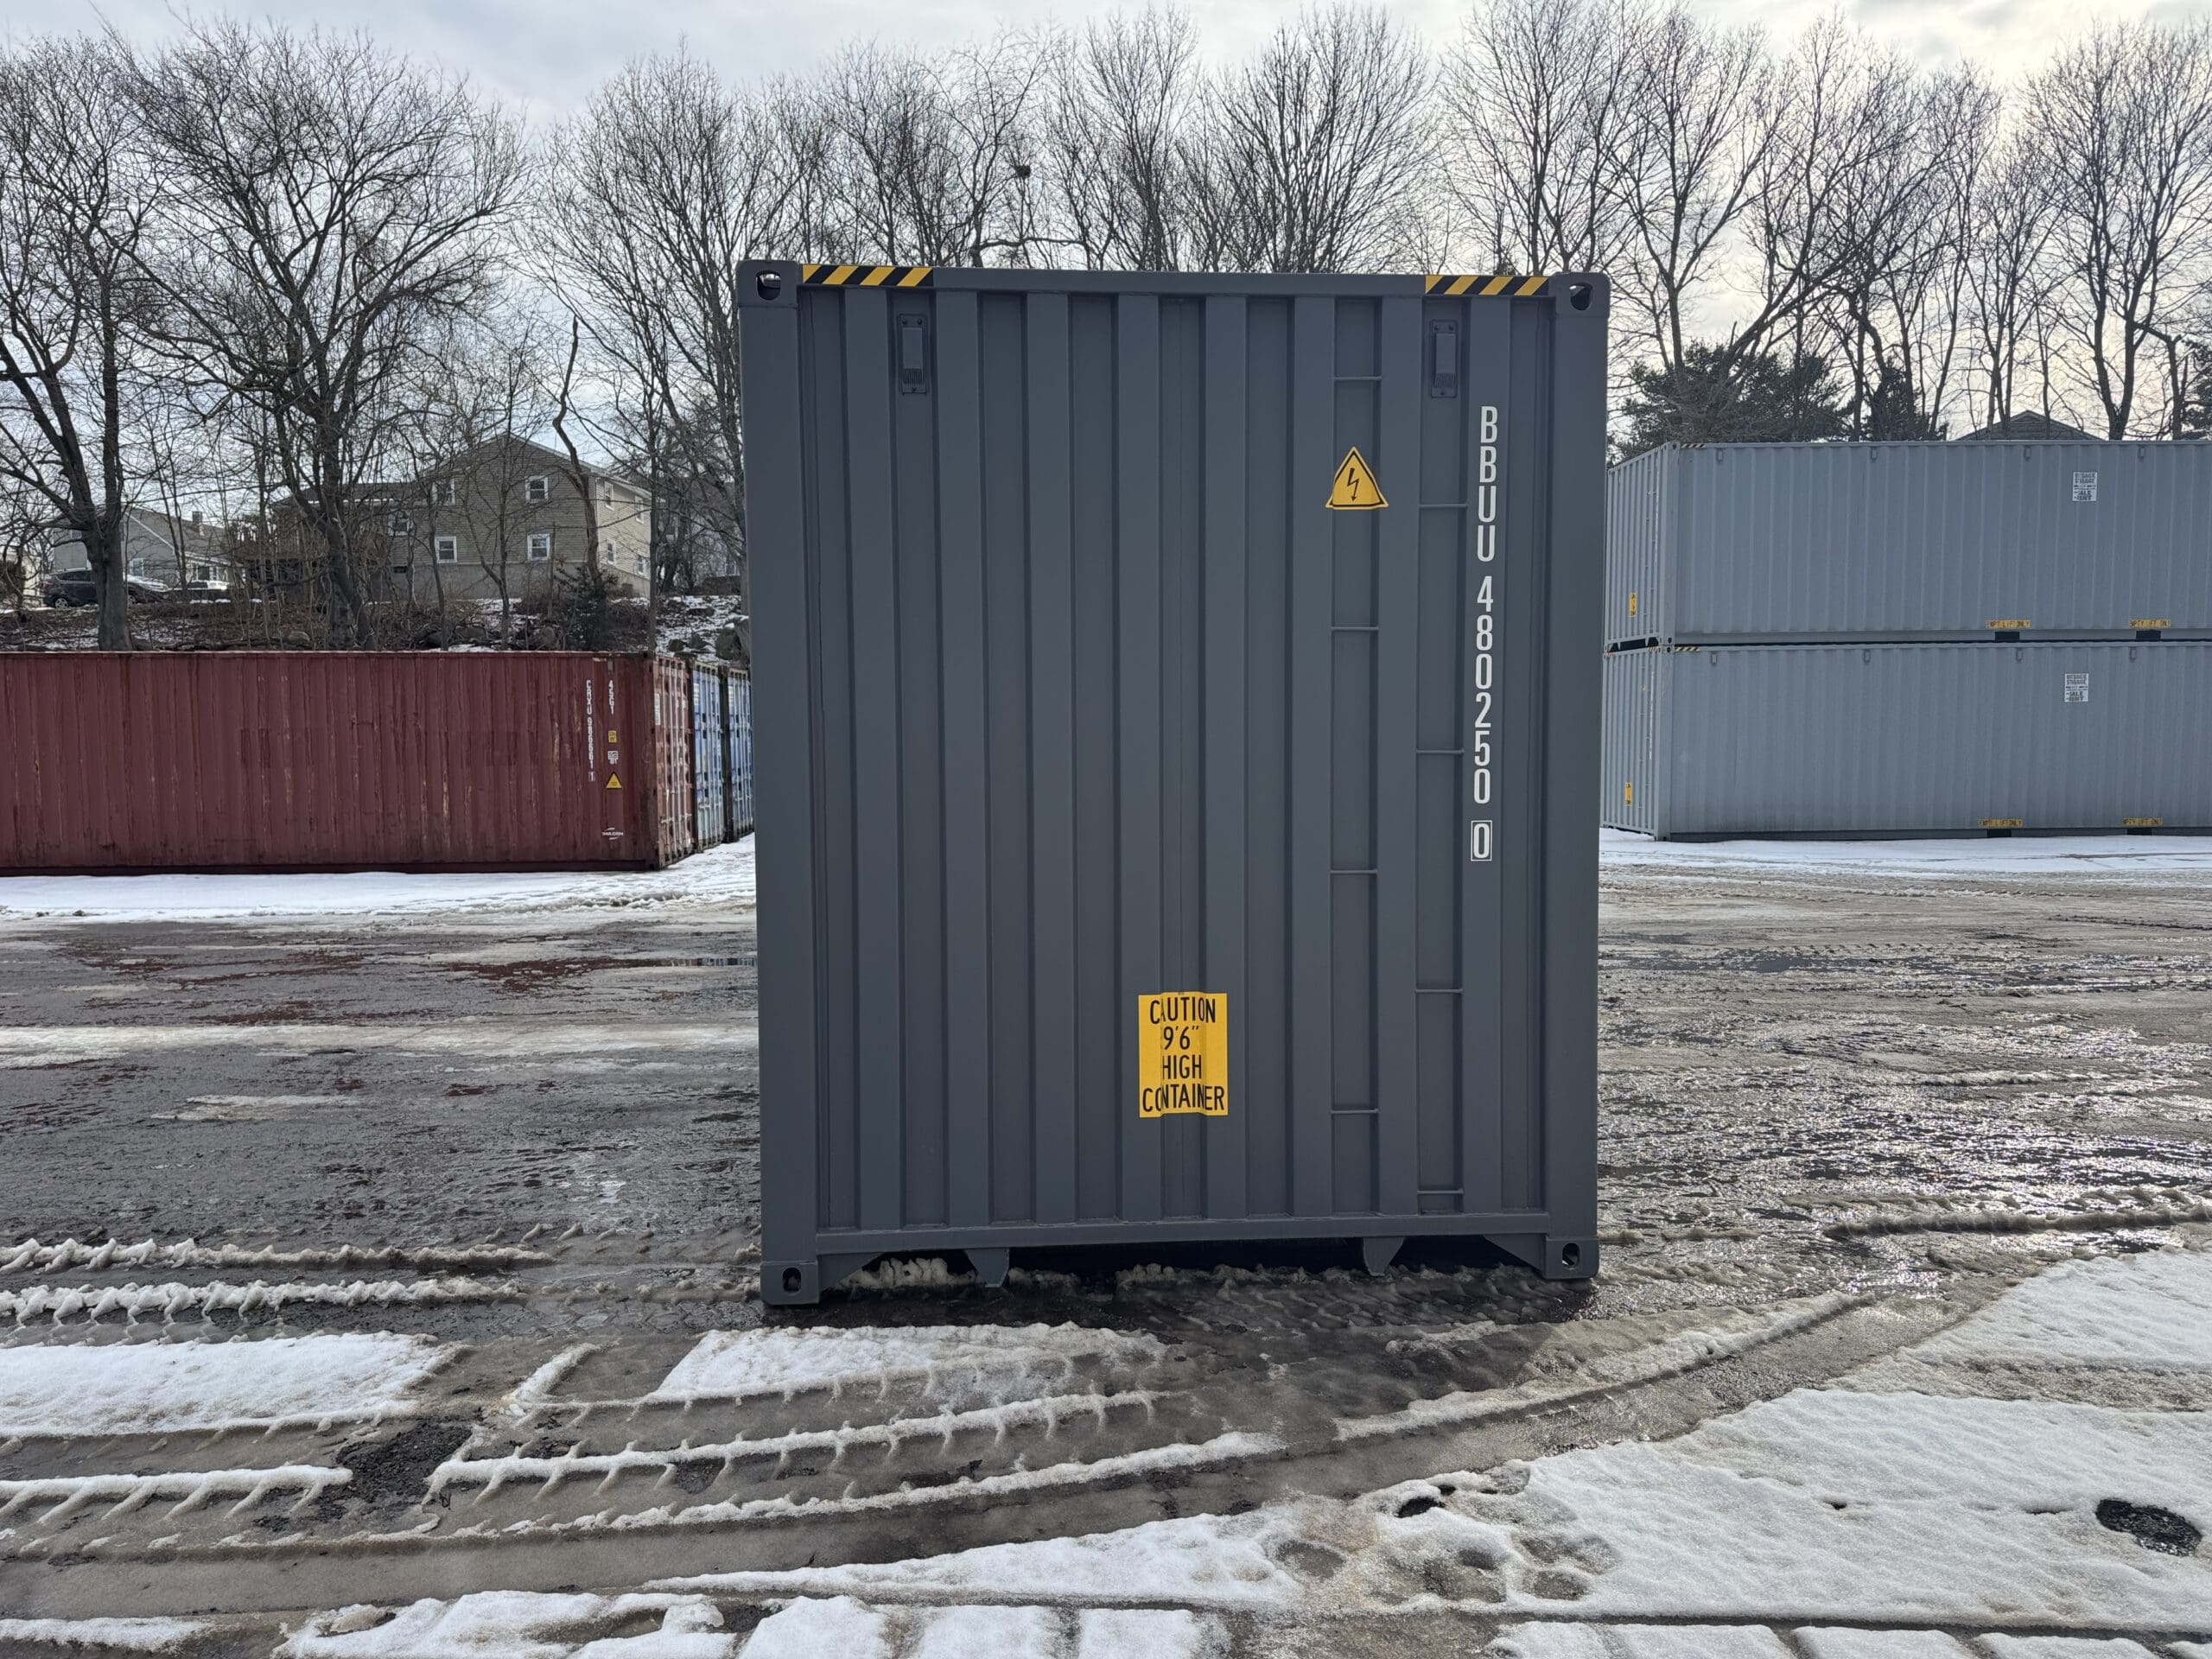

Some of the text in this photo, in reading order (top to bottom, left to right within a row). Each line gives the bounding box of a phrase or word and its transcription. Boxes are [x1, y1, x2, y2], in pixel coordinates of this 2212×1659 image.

[1472, 405, 1498, 859] BBUU 480250 0
[1150, 996, 1216, 1025] CAUTION
[1162, 1054, 1202, 1080] HIGH
[1142, 1083, 1225, 1113] CONTAINER
